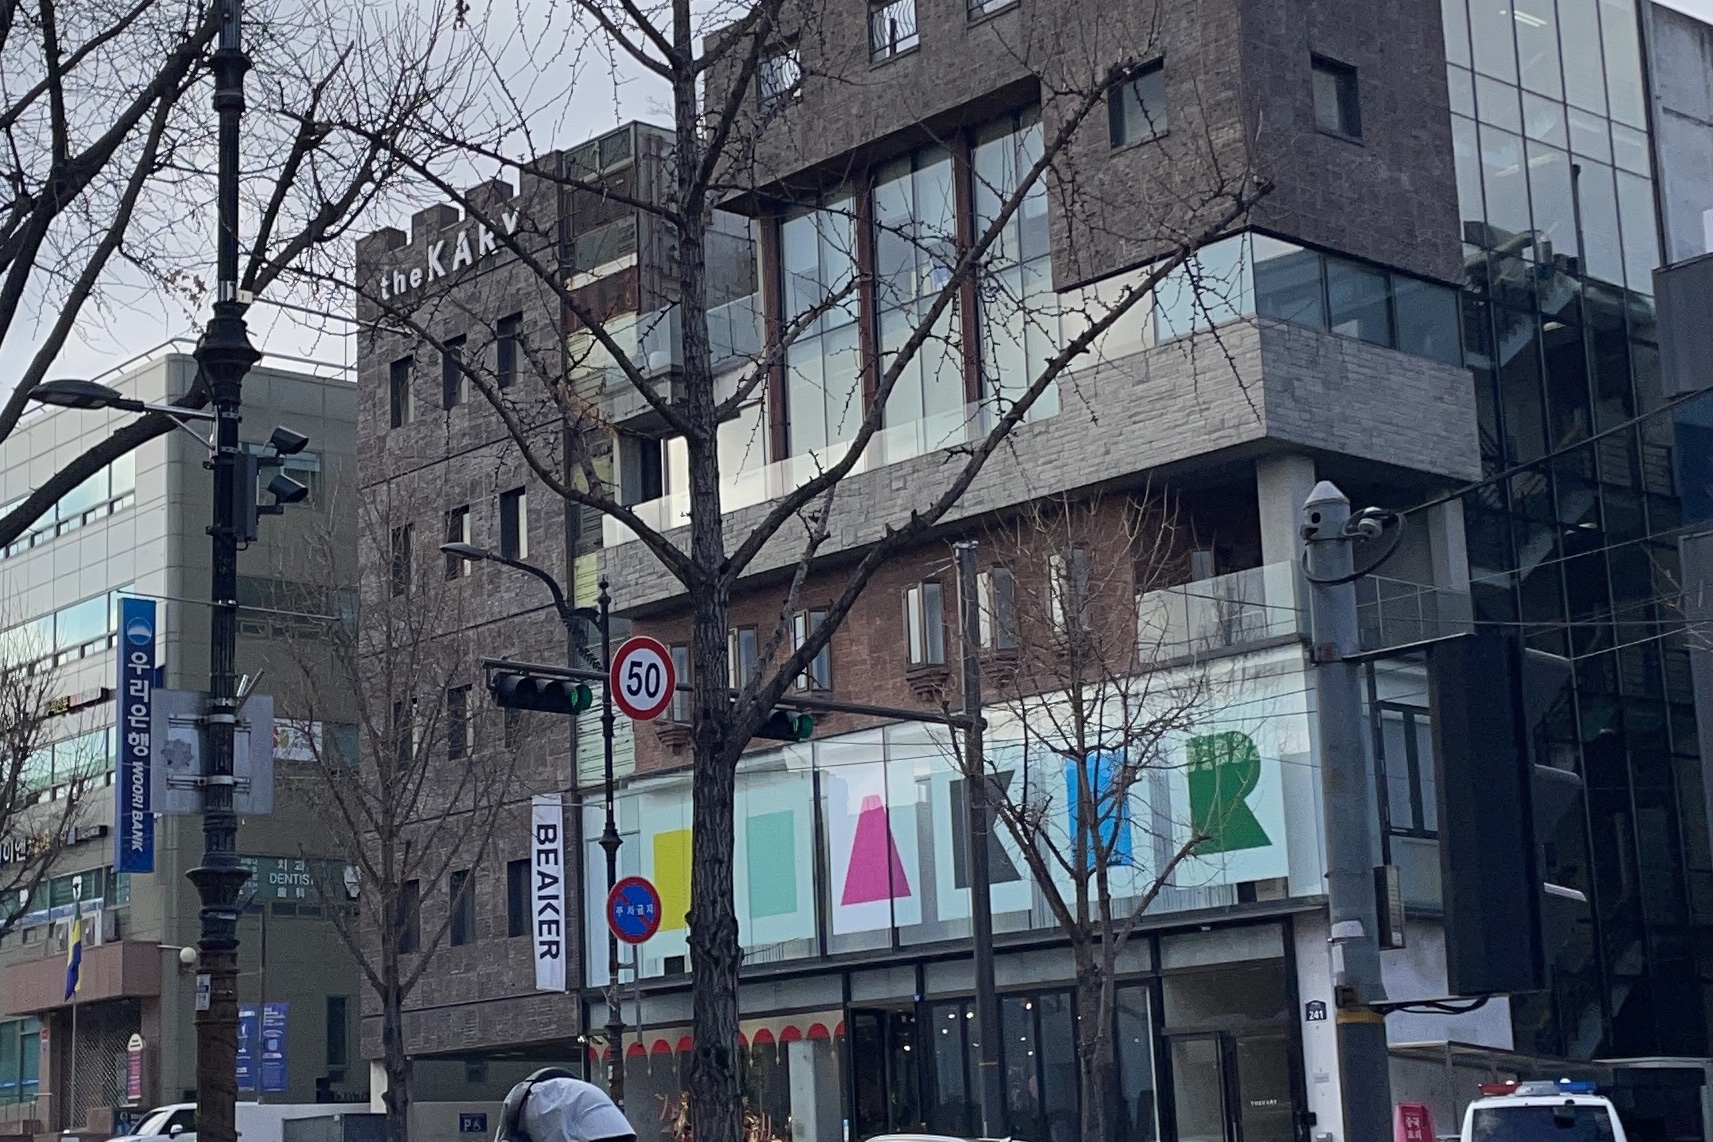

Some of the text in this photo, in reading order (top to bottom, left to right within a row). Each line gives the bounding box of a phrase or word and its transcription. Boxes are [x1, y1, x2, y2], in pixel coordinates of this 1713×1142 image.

[127, 651, 151, 757] 우리은행
[626, 660, 661, 699] 50
[131, 761, 144, 853] WOORI BANK
[536, 823, 561, 960] BEAKER
[1308, 1010, 1324, 1020] 241
[463, 1119, 472, 1132] P
